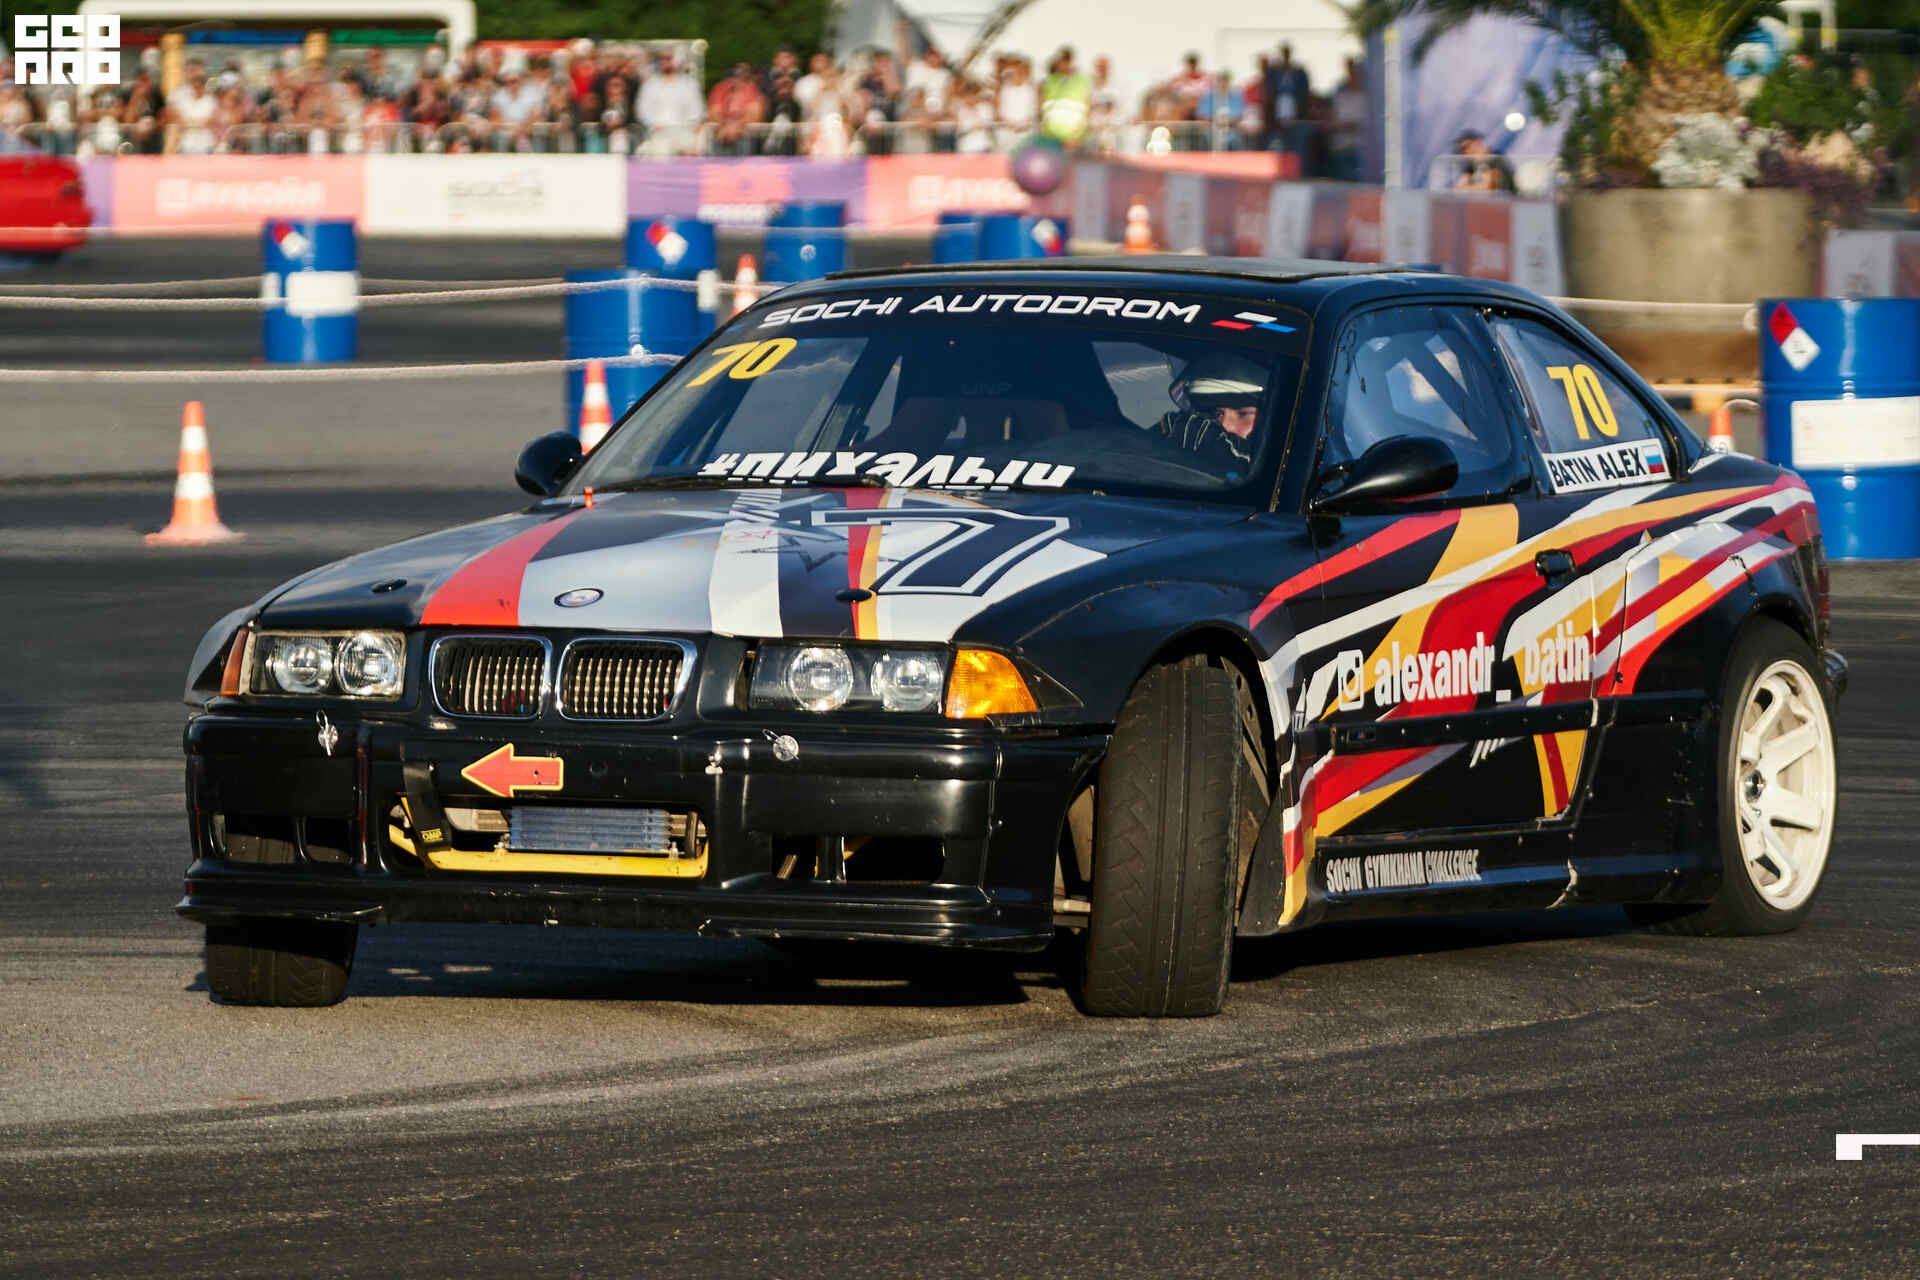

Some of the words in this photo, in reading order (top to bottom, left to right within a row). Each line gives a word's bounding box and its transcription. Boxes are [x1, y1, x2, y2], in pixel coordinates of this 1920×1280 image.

[759, 297, 902, 329] SOCHI
[909, 294, 1202, 323] AUTODROM
[686, 337, 798, 388] 70
[1546, 364, 1619, 440] 70
[1548, 453, 1600, 488] BATIN
[1597, 448, 1647, 480] ALEX
[1326, 857, 1363, 892] SOCHI
[1364, 852, 1426, 888] GYMKHANA
[1425, 849, 1481, 883] CHALLENGE
